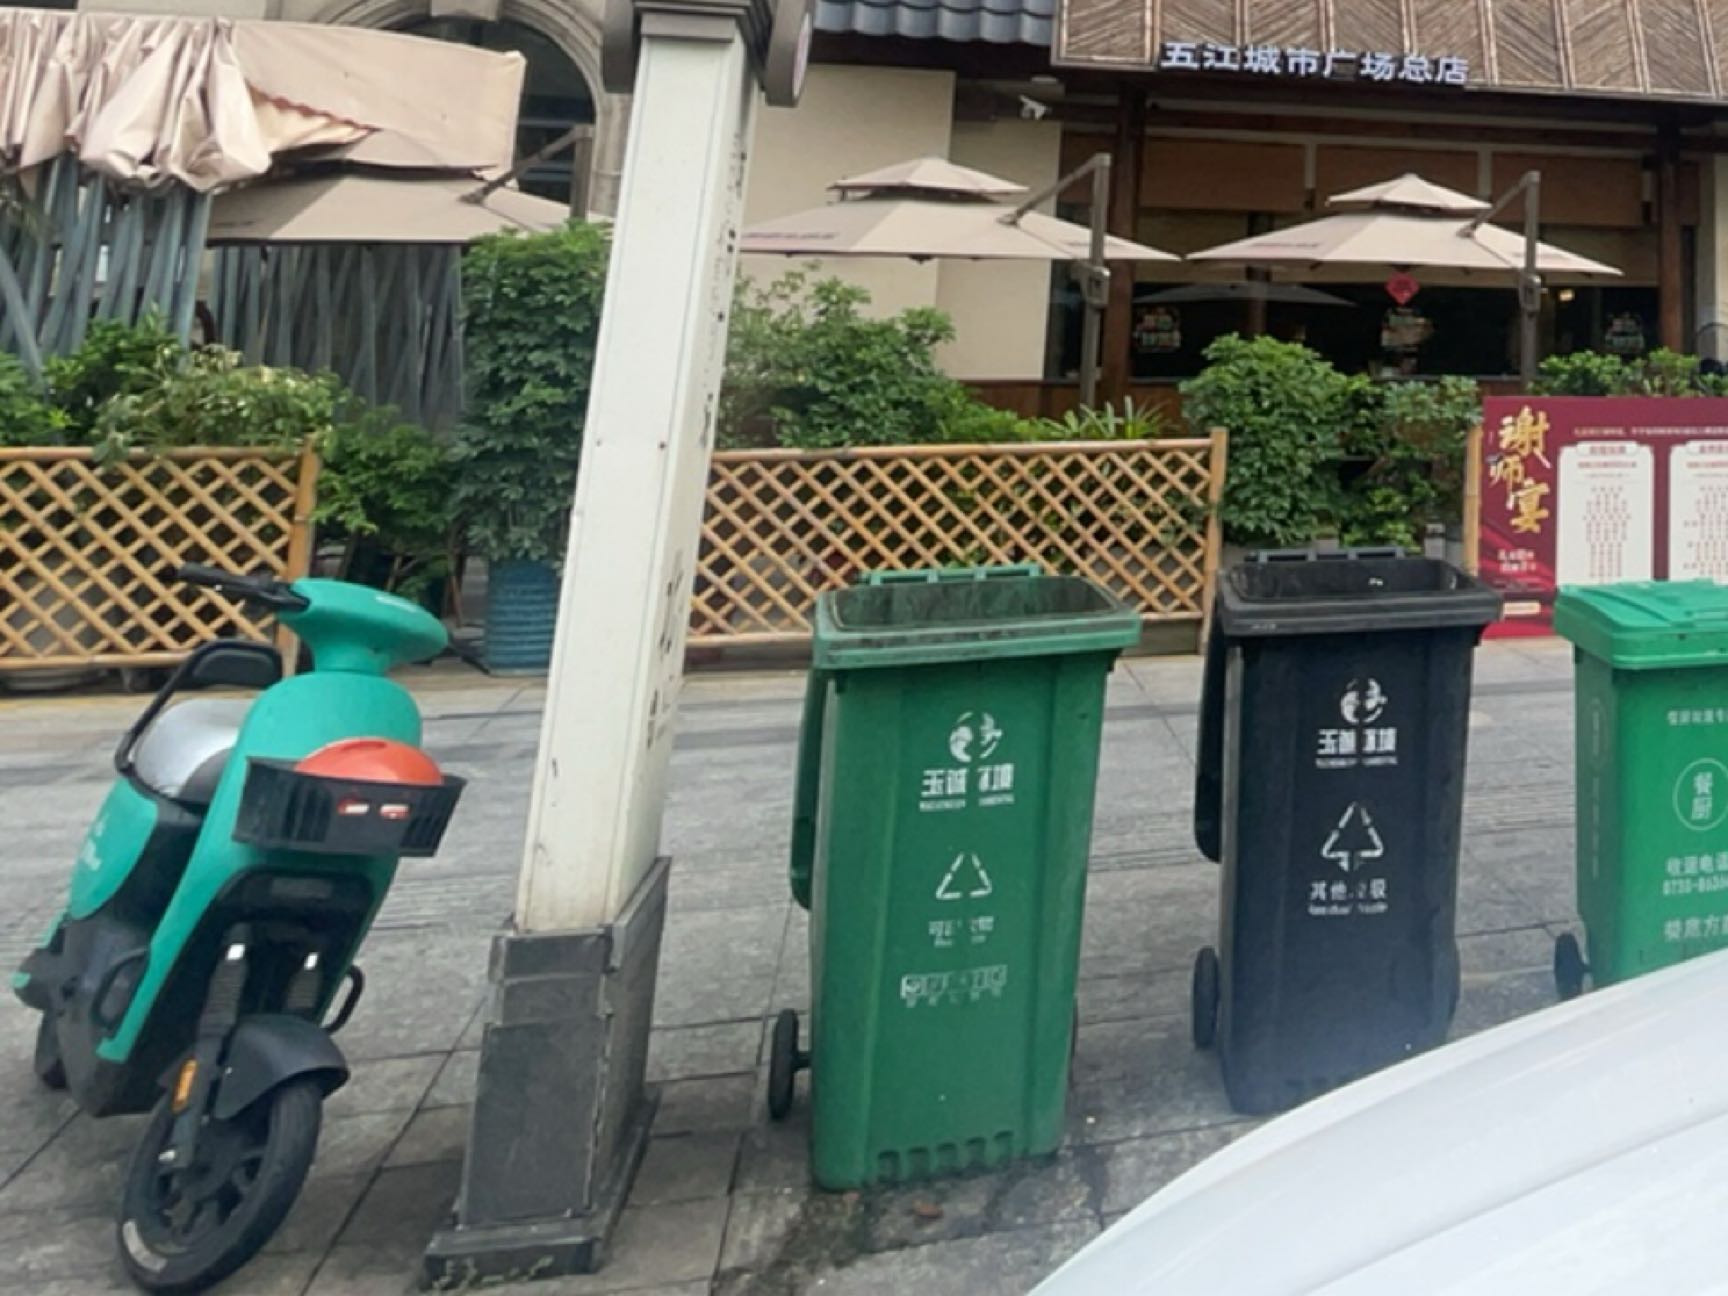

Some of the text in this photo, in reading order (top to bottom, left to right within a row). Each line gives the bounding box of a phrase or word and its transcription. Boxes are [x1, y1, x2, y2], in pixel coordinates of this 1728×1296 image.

[1158, 41, 1470, 86] 五江城市广场总店
